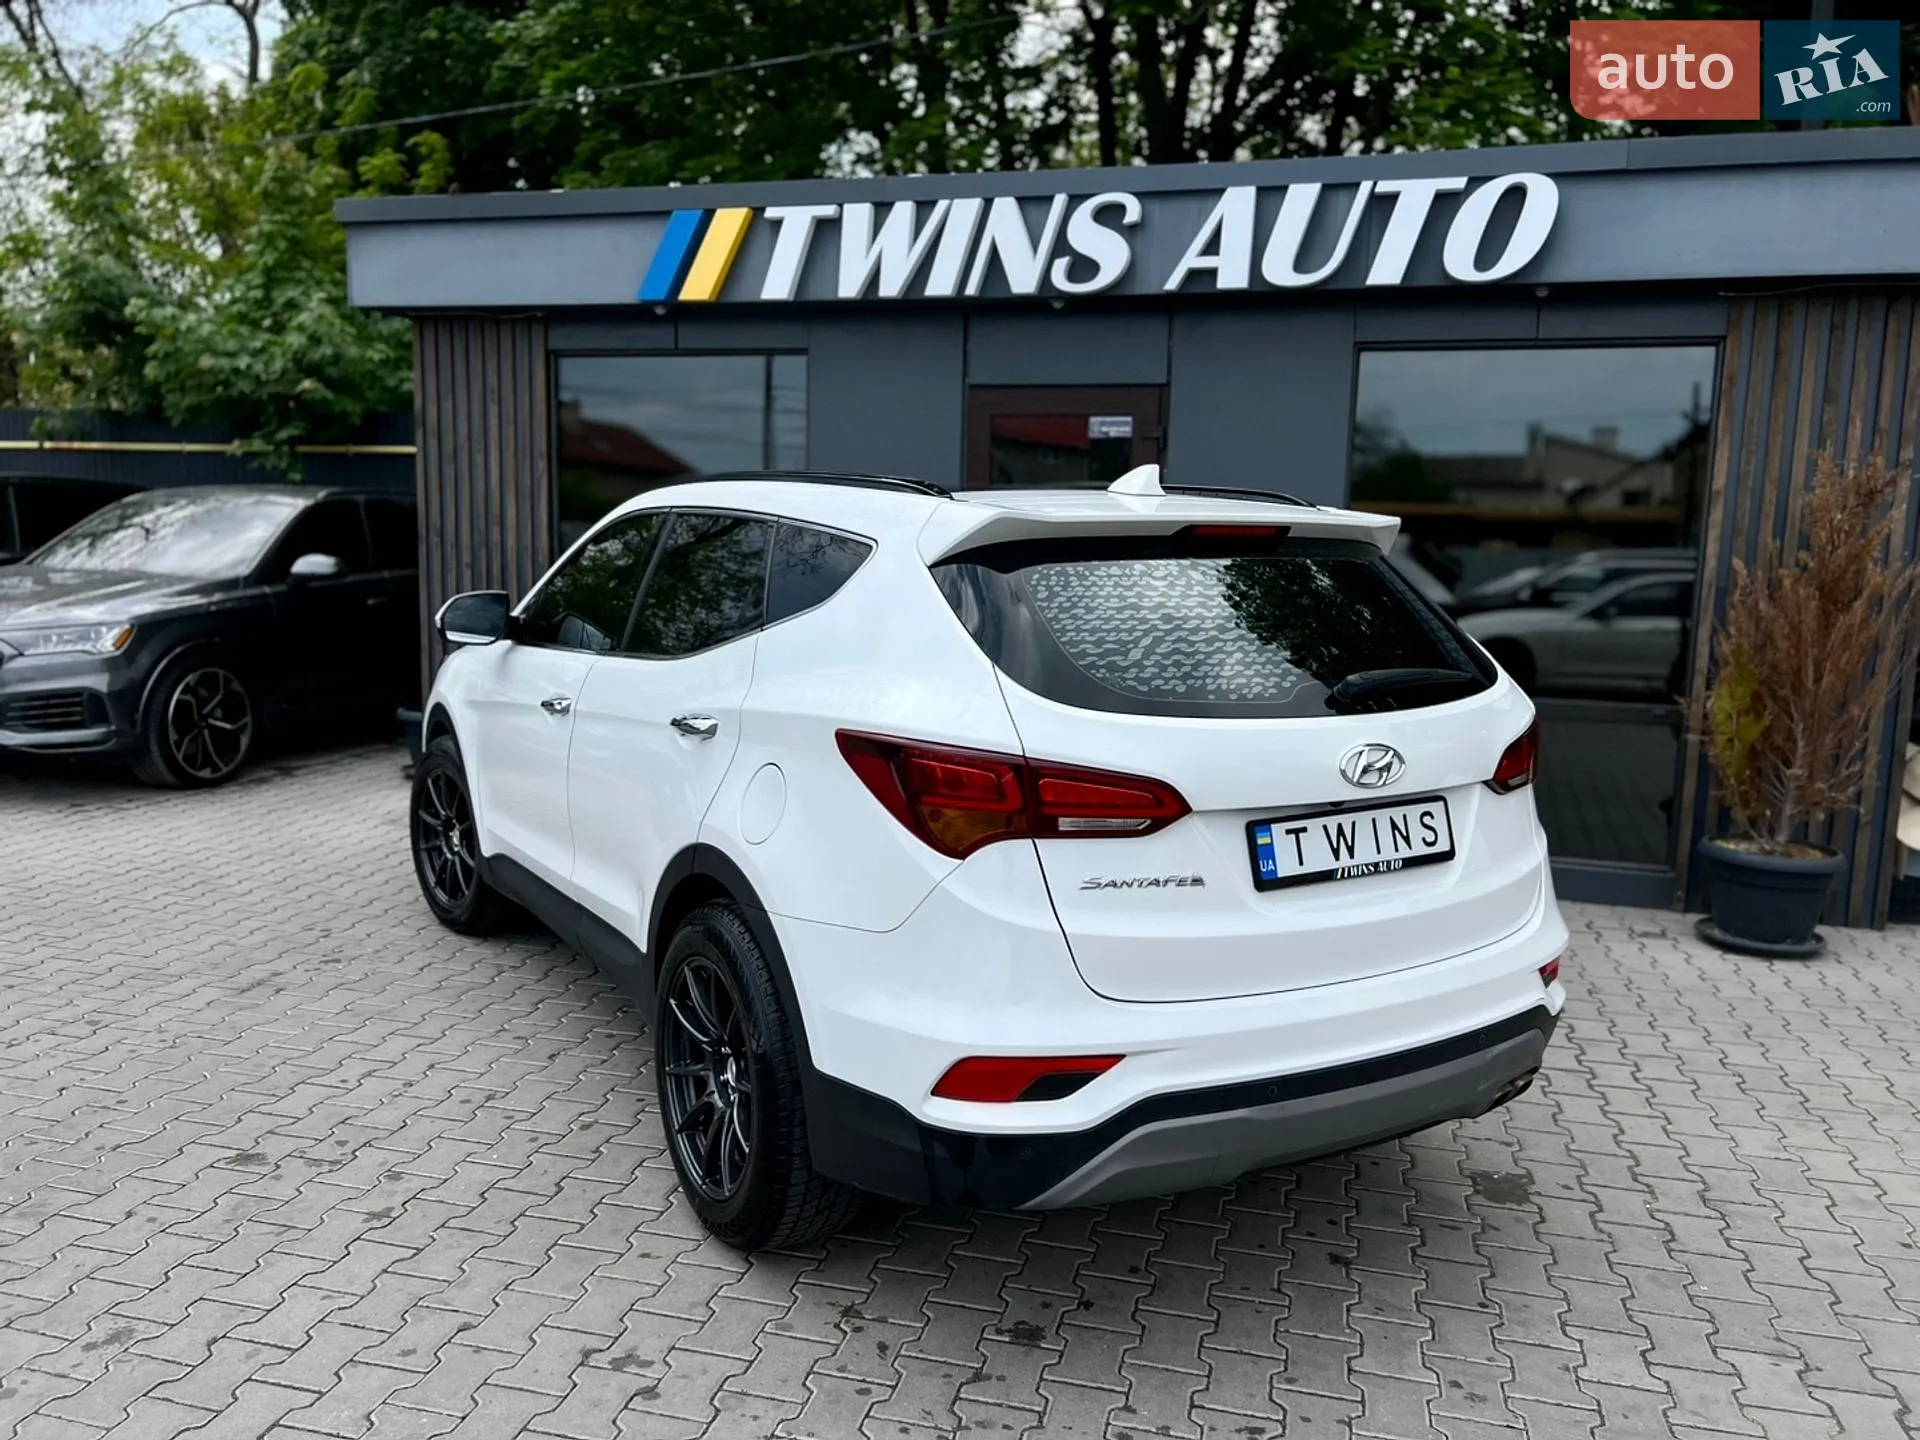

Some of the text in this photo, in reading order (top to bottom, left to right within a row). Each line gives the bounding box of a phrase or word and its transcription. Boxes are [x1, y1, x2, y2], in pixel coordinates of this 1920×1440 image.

[760, 172, 1559, 301] TWINS AUTO
[1260, 860, 1275, 872] UA
[1285, 811, 1439, 867] TWINS
